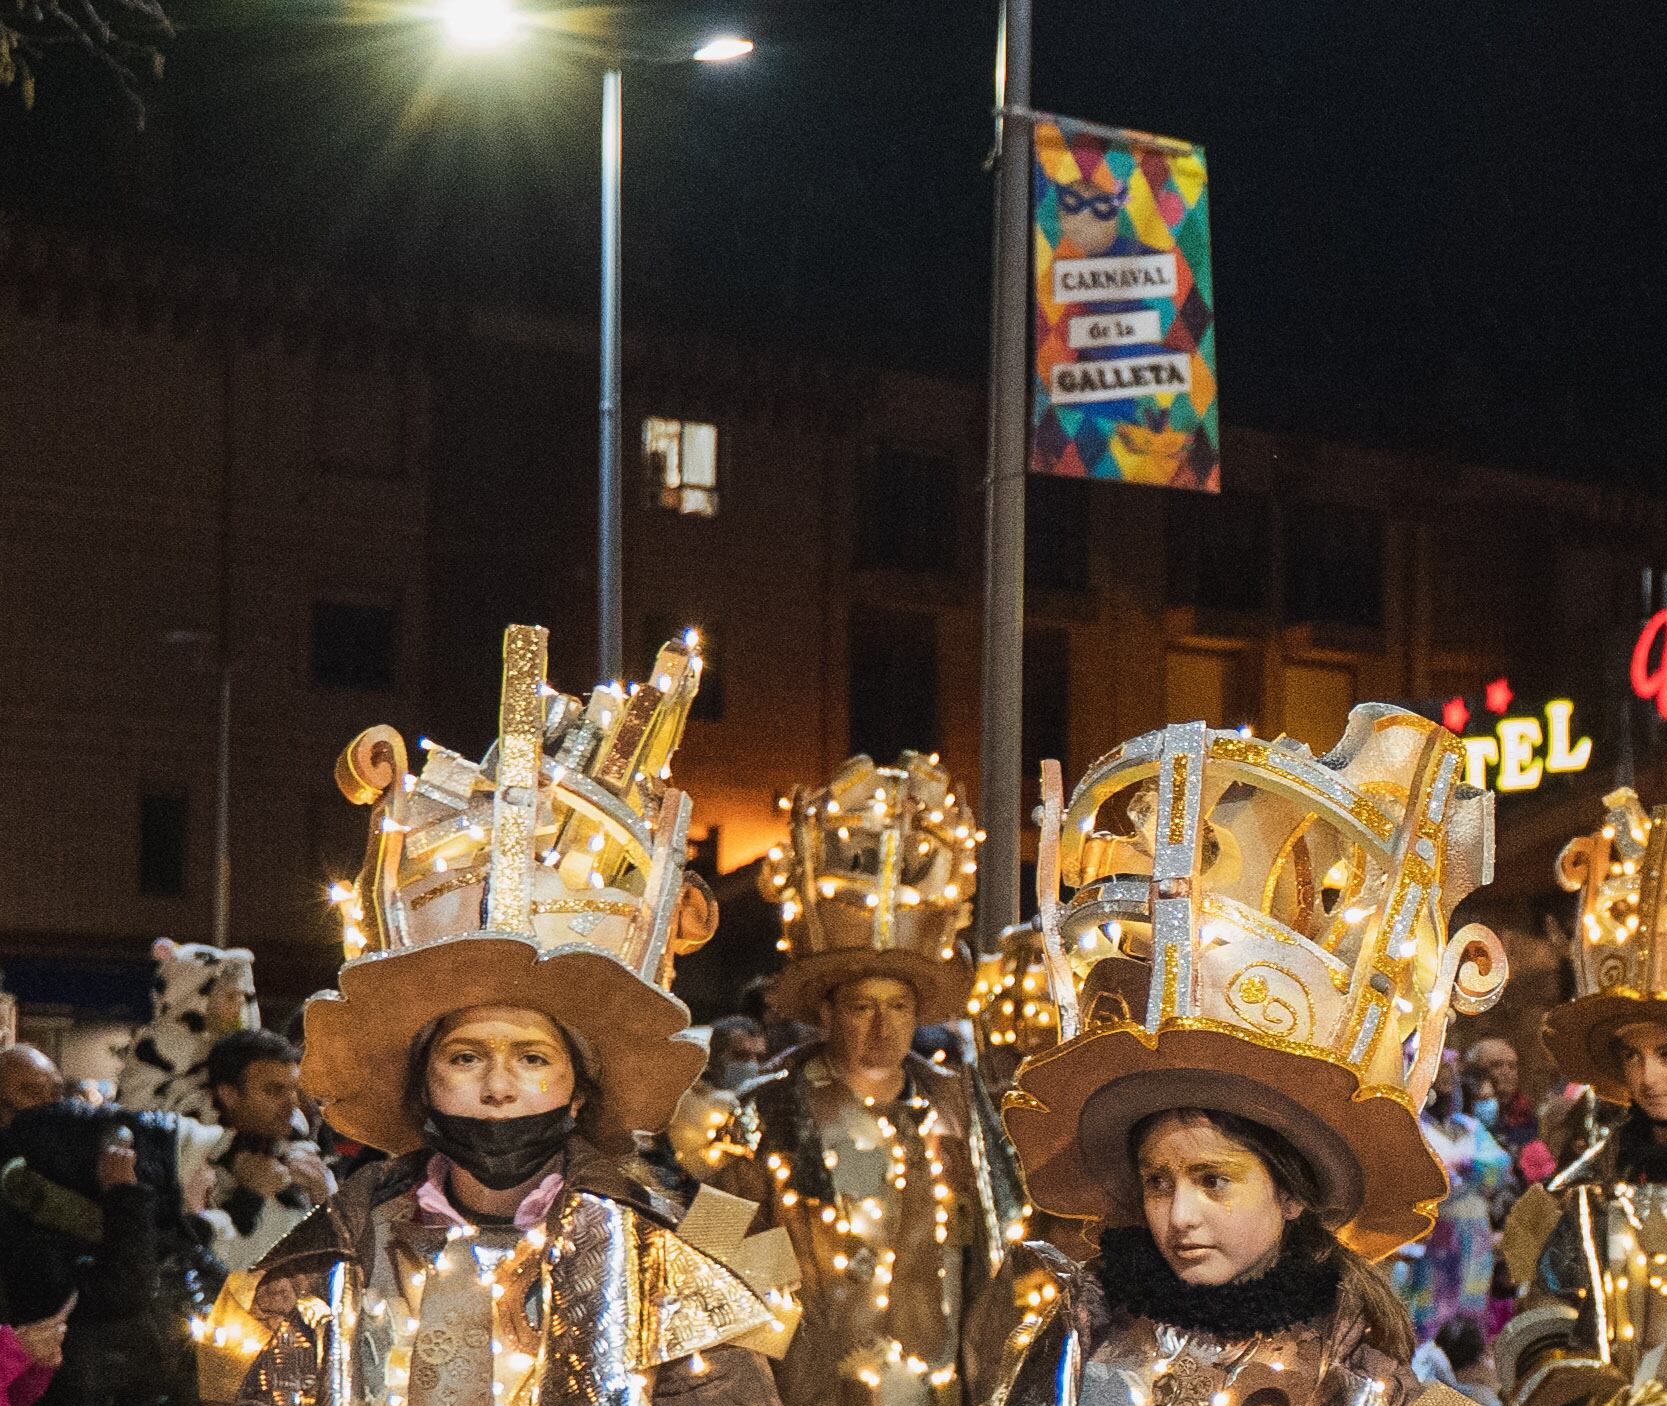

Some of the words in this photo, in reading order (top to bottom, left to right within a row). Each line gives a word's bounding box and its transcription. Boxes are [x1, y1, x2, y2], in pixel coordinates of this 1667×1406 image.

[1060, 266, 1171, 291] CARNAVAL
[1088, 321, 1111, 339] de
[1114, 319, 1134, 337] la
[1056, 361, 1186, 393] GALLETA
